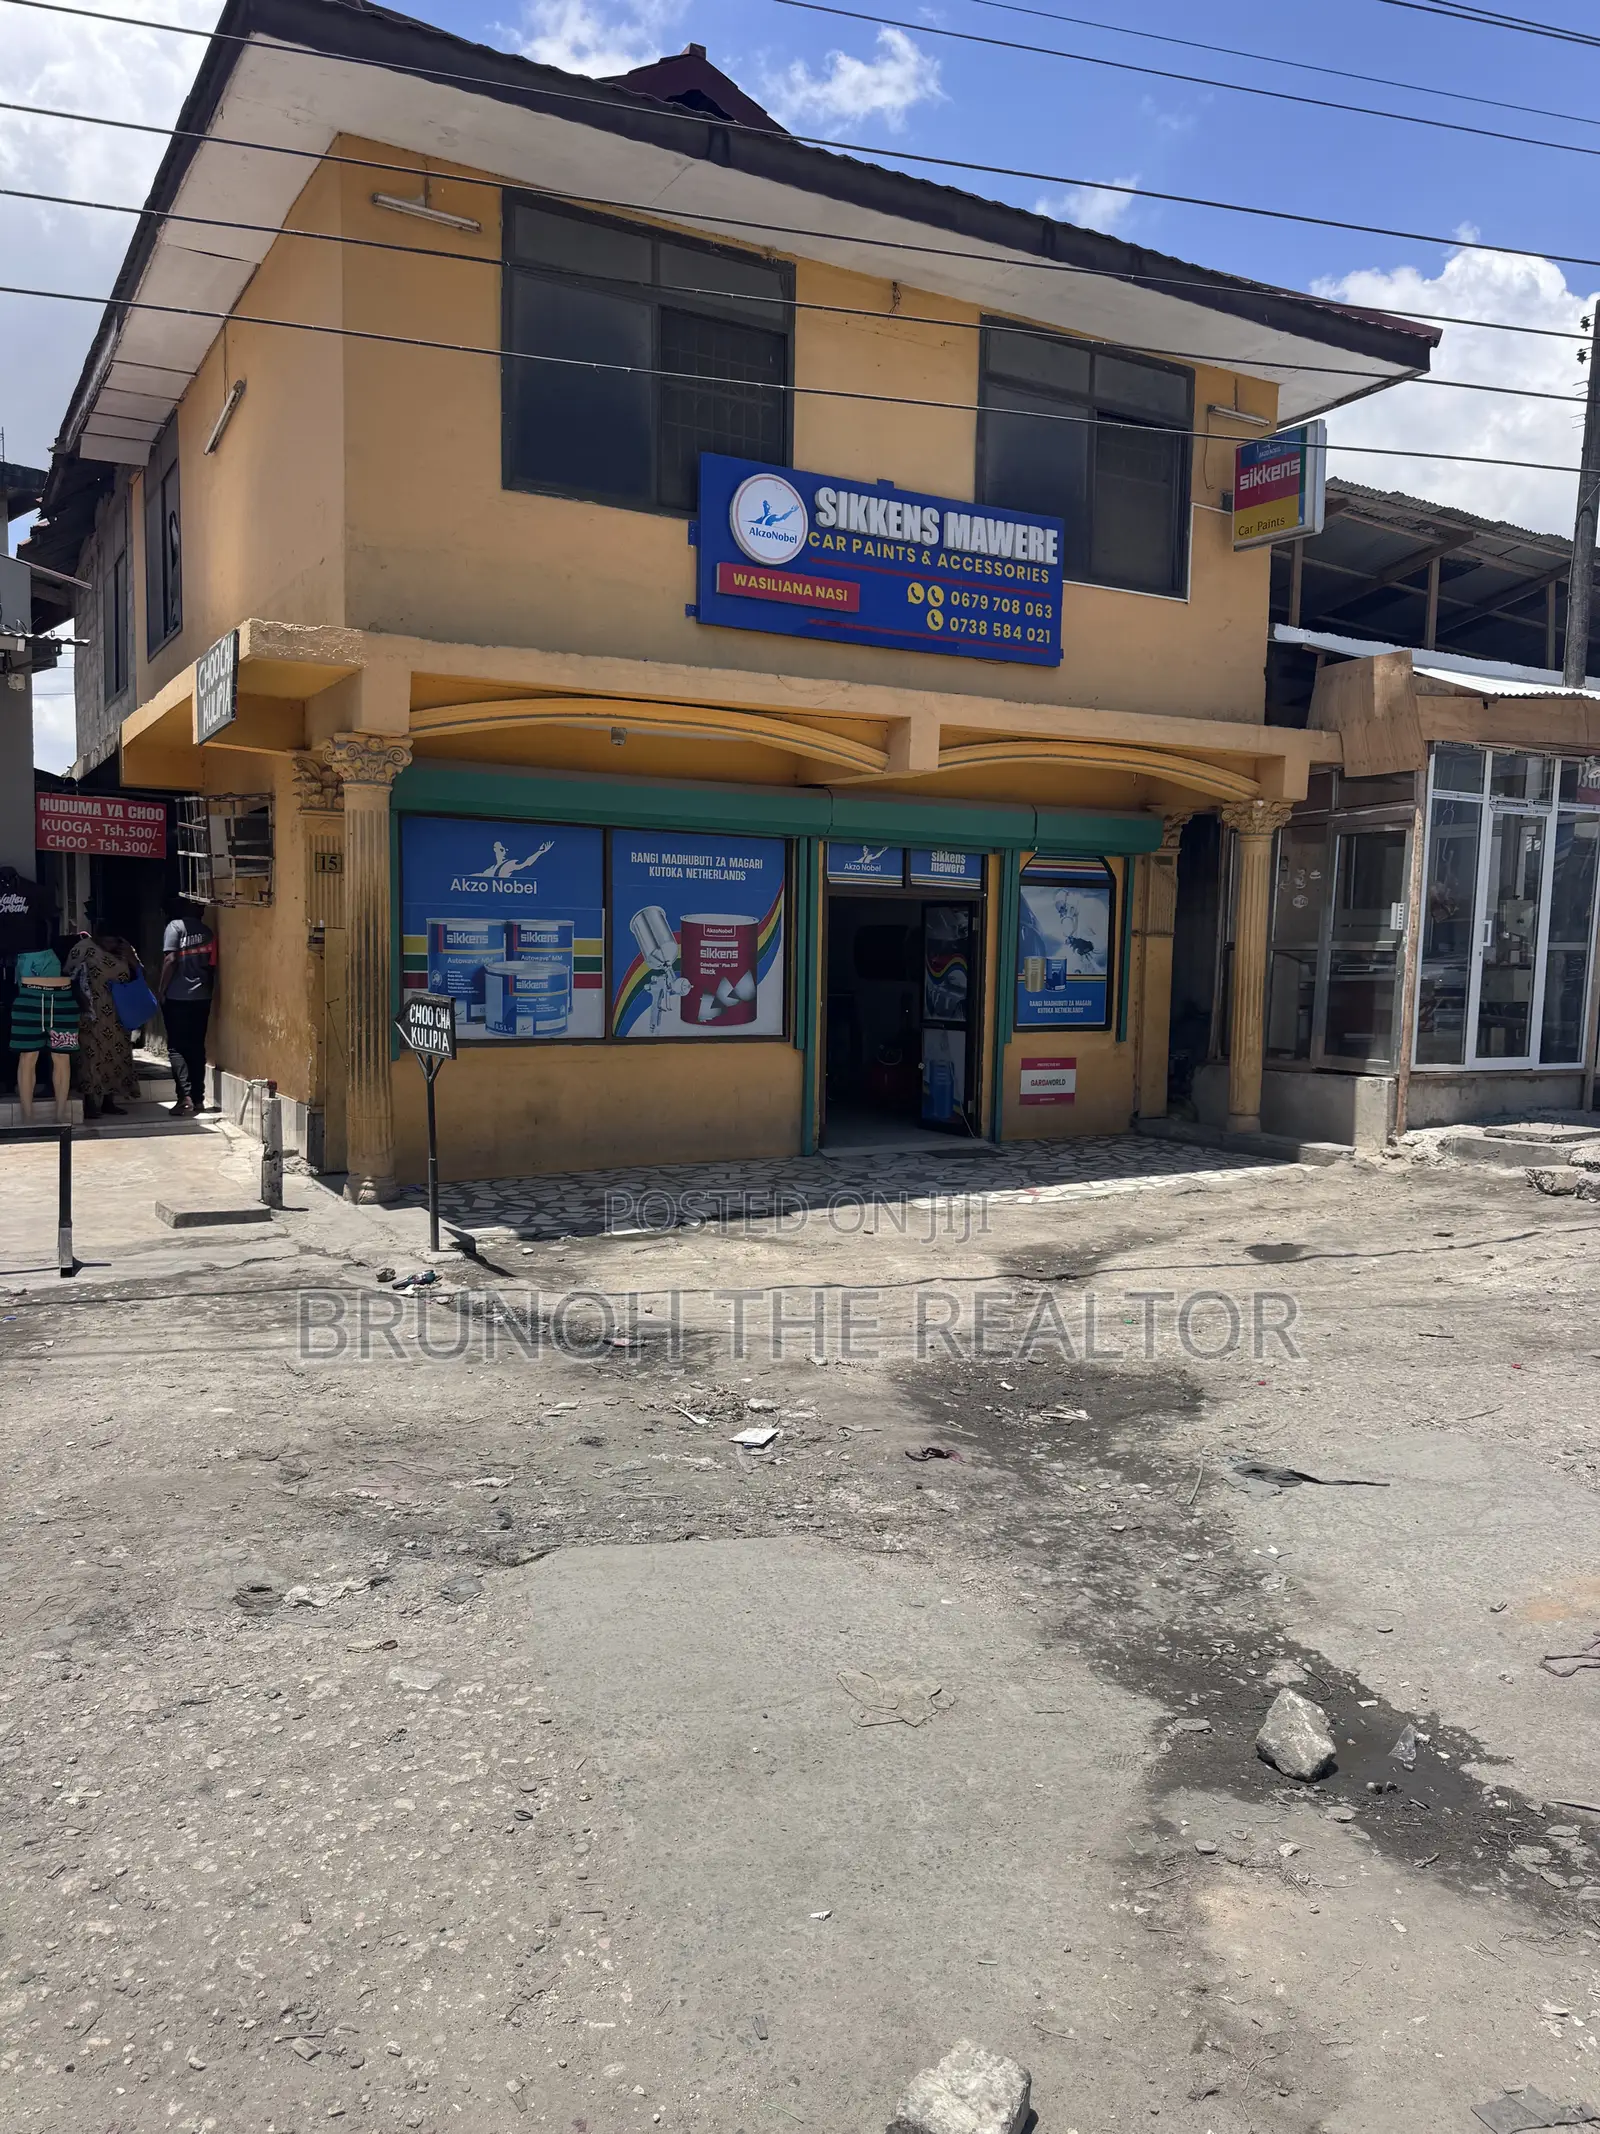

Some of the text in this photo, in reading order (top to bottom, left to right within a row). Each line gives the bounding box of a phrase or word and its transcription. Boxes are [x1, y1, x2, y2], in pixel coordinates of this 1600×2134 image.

[1240, 458, 1300, 491] sikkens
[815, 486, 1059, 565] SIKKENS MAWERE
[1238, 517, 1286, 536] Car Paints
[749, 526, 798, 545] AkzoNobel
[808, 531, 1050, 584] CAR PAINTS & ACCESSORIES
[732, 572, 848, 602] WASILIANA NASI
[950, 590, 1053, 619] 0679 708 063
[950, 618, 1051, 644] 0738 584 021
[198, 634, 234, 698] CHOO CHA
[203, 676, 231, 734] KULIPIA
[40, 798, 164, 821] HUDUMA YA CHOO
[41, 818, 93, 834] KUOGA
[102, 823, 162, 840] Tsh.500/-
[46, 834, 88, 849] CHOO
[97, 838, 158, 854] Tsh.300/-
[319, 854, 338, 872] 15
[630, 852, 764, 870] RANGI MADHUBUTI ZA MAGARI
[931, 850, 966, 864] sikkens
[649, 866, 746, 882] KUTOKA NETHERLANDS
[844, 863, 882, 872] Akzo Nobel
[930, 862, 965, 874] mawere
[450, 878, 538, 895] Akzo Nobel
[446, 932, 489, 944] sikkens
[520, 932, 559, 944] sikkens
[700, 948, 739, 959] sikkens
[516, 980, 548, 989] sikkens
[408, 1002, 452, 1031] CHOO CHA
[410, 1027, 451, 1052] KULIPIA
